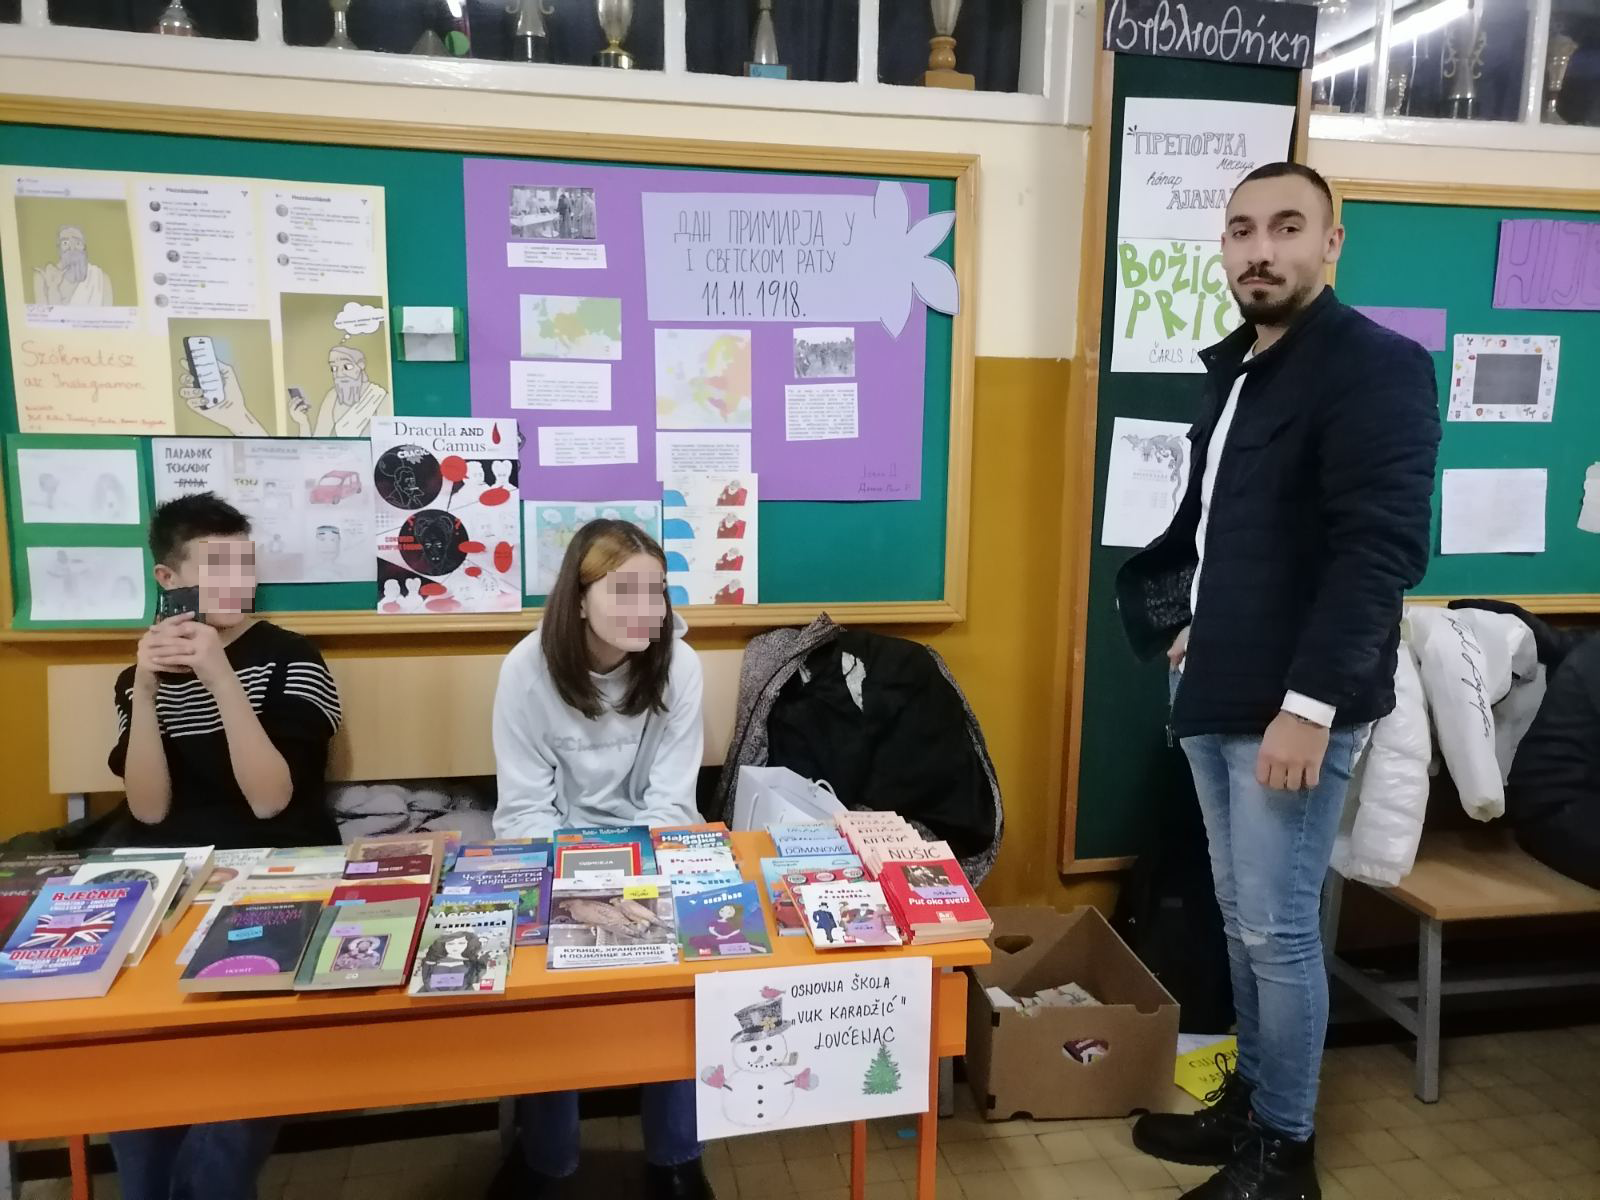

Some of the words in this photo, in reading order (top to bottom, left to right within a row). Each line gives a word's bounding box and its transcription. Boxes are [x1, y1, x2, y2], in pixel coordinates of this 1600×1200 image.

[673, 211, 711, 246] ДАН
[728, 209, 825, 247] ПРИМИРЈА
[843, 212, 857, 248] У
[706, 247, 786, 274] СВЕТСКОМ
[797, 249, 837, 274] РАТУ
[1125, 288, 1233, 341] PRIČ
[393, 421, 456, 437] Dracula
[460, 427, 485, 437] AND
[432, 437, 487, 453] Camus
[888, 846, 941, 860] NUŠIĆ
[908, 897, 925, 906] Put
[9, 943, 103, 961] DICTIONARY
[791, 979, 844, 999] OSNOVNA
[851, 973, 891, 991] ŠKOLA
[814, 1026, 897, 1050] LOVĆENAC
